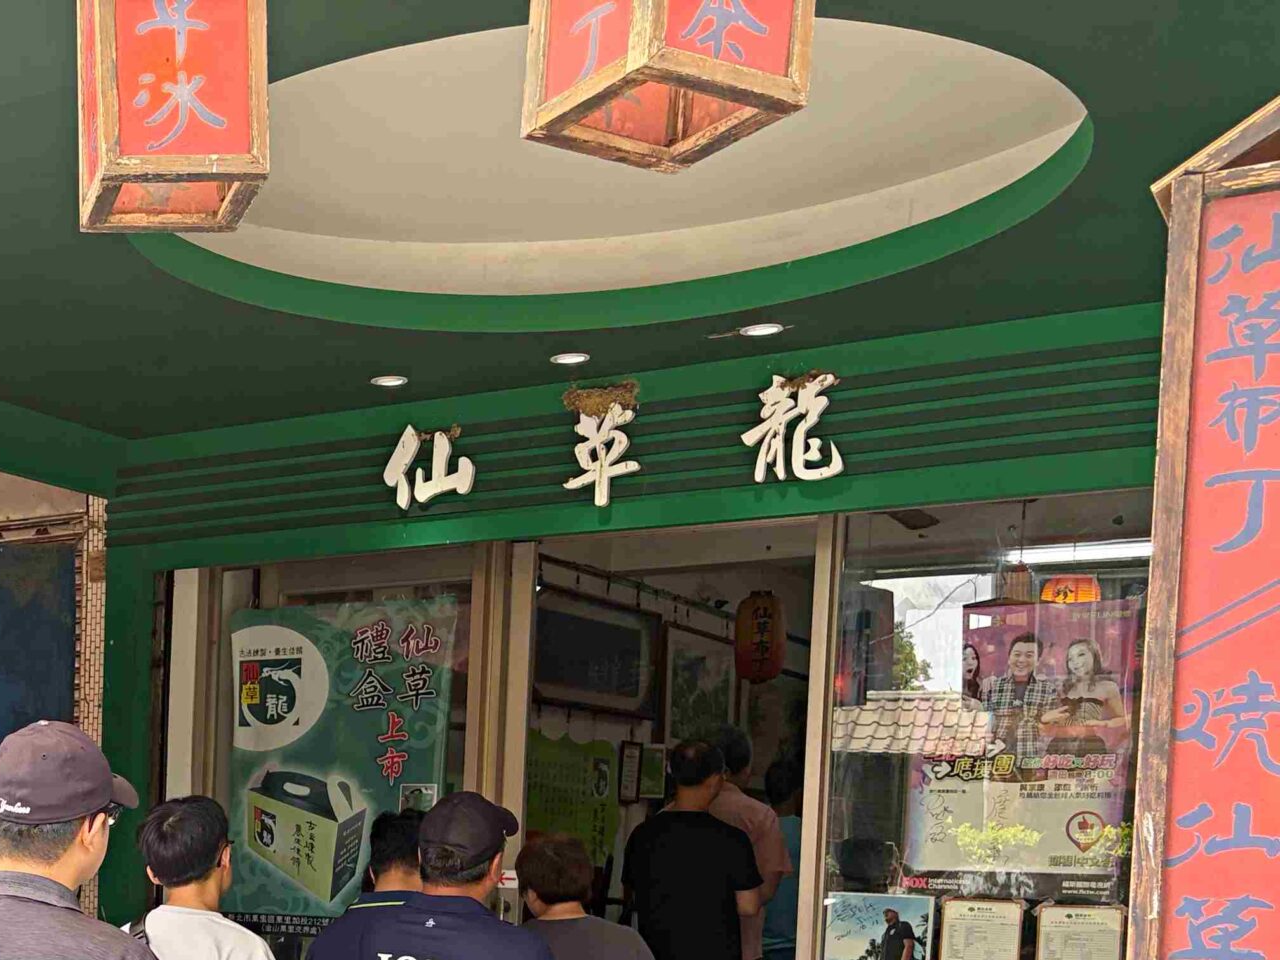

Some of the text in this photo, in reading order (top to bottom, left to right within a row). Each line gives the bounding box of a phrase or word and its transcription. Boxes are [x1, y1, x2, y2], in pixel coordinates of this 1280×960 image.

[382, 374, 845, 511] 仙草龍
[265, 693, 289, 720] 龍
[350, 620, 393, 711] 禮盒
[397, 623, 441, 711] 仙草
[377, 712, 409, 786] 上市
